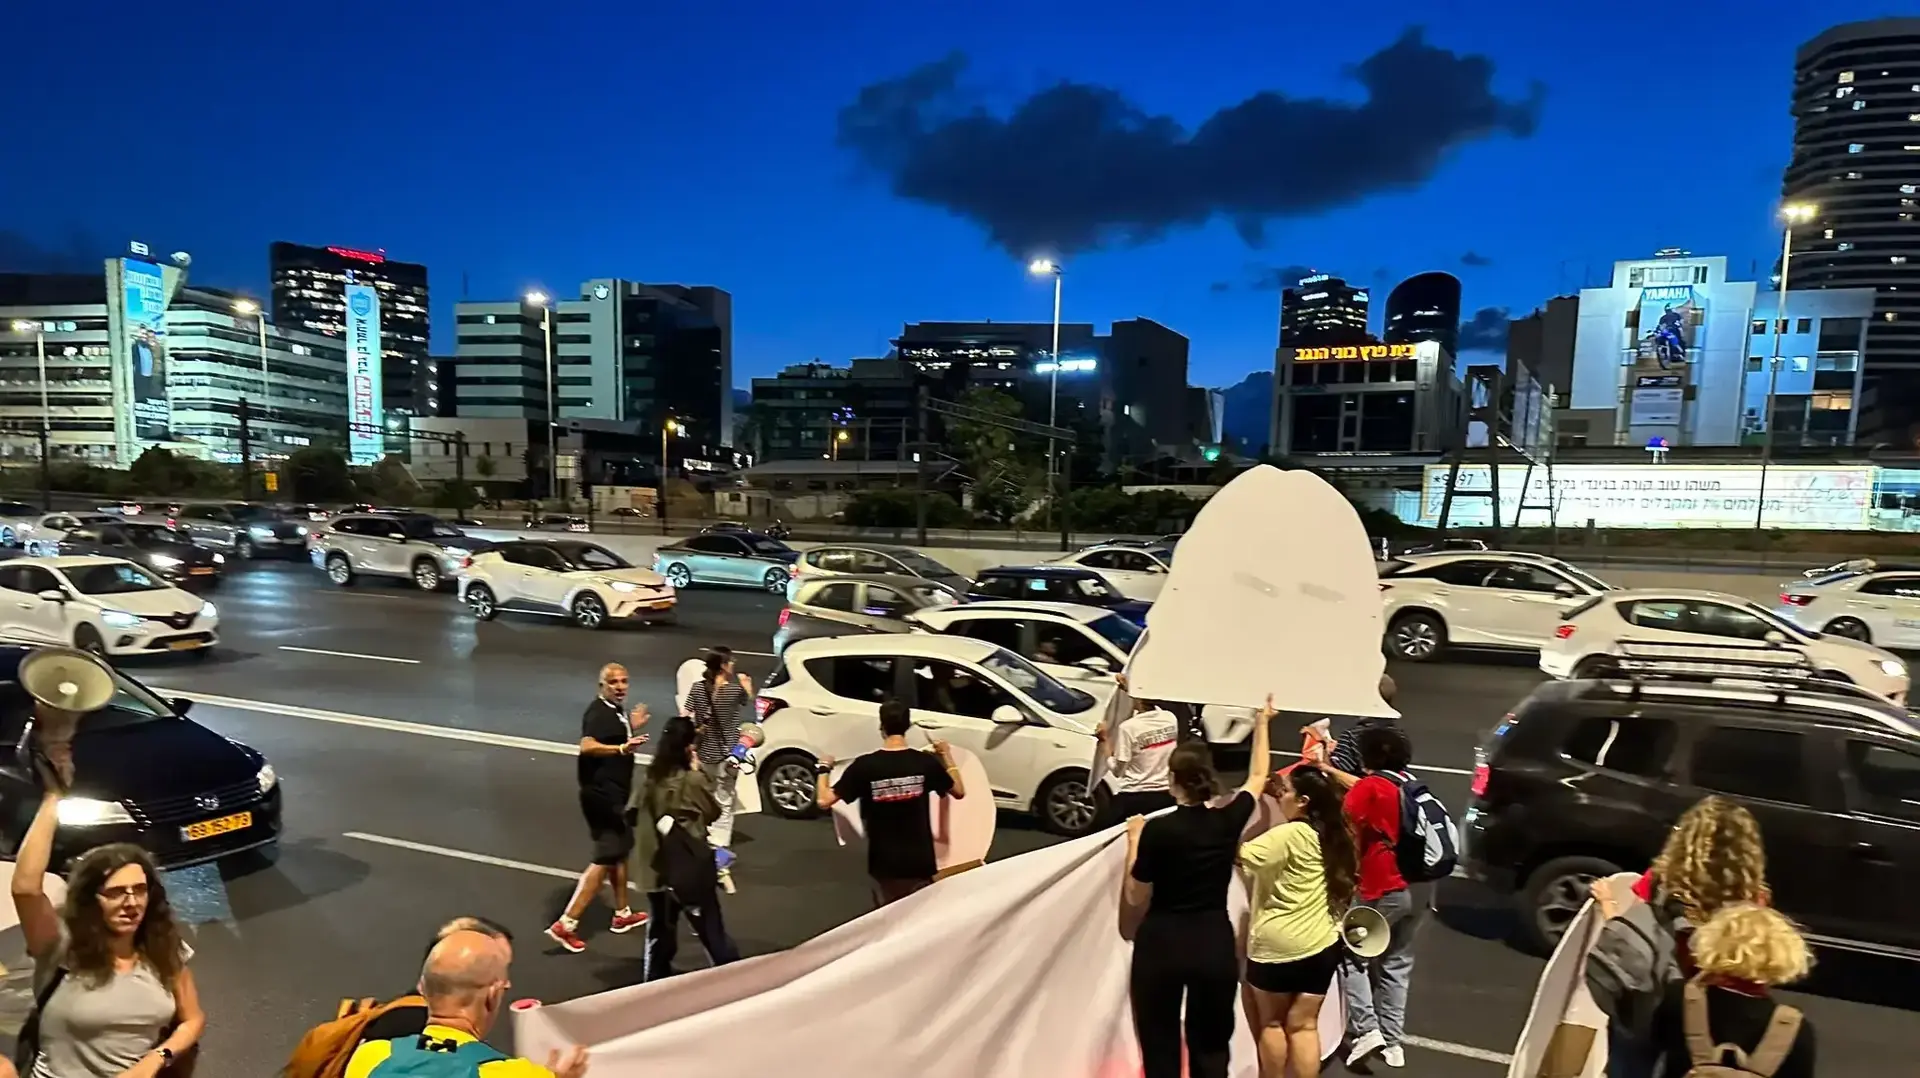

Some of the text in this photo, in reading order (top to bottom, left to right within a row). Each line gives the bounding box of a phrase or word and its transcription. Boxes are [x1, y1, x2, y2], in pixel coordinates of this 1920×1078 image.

[1645, 287, 1690, 300] YAMAHA
[1294, 347, 1330, 360] הנגב
[1359, 345, 1388, 361] פרץ
[1389, 344, 1417, 359] בית
[1620, 480, 1653, 491] קורה
[1657, 480, 1681, 491] טוב
[1684, 480, 1721, 491] משהו
